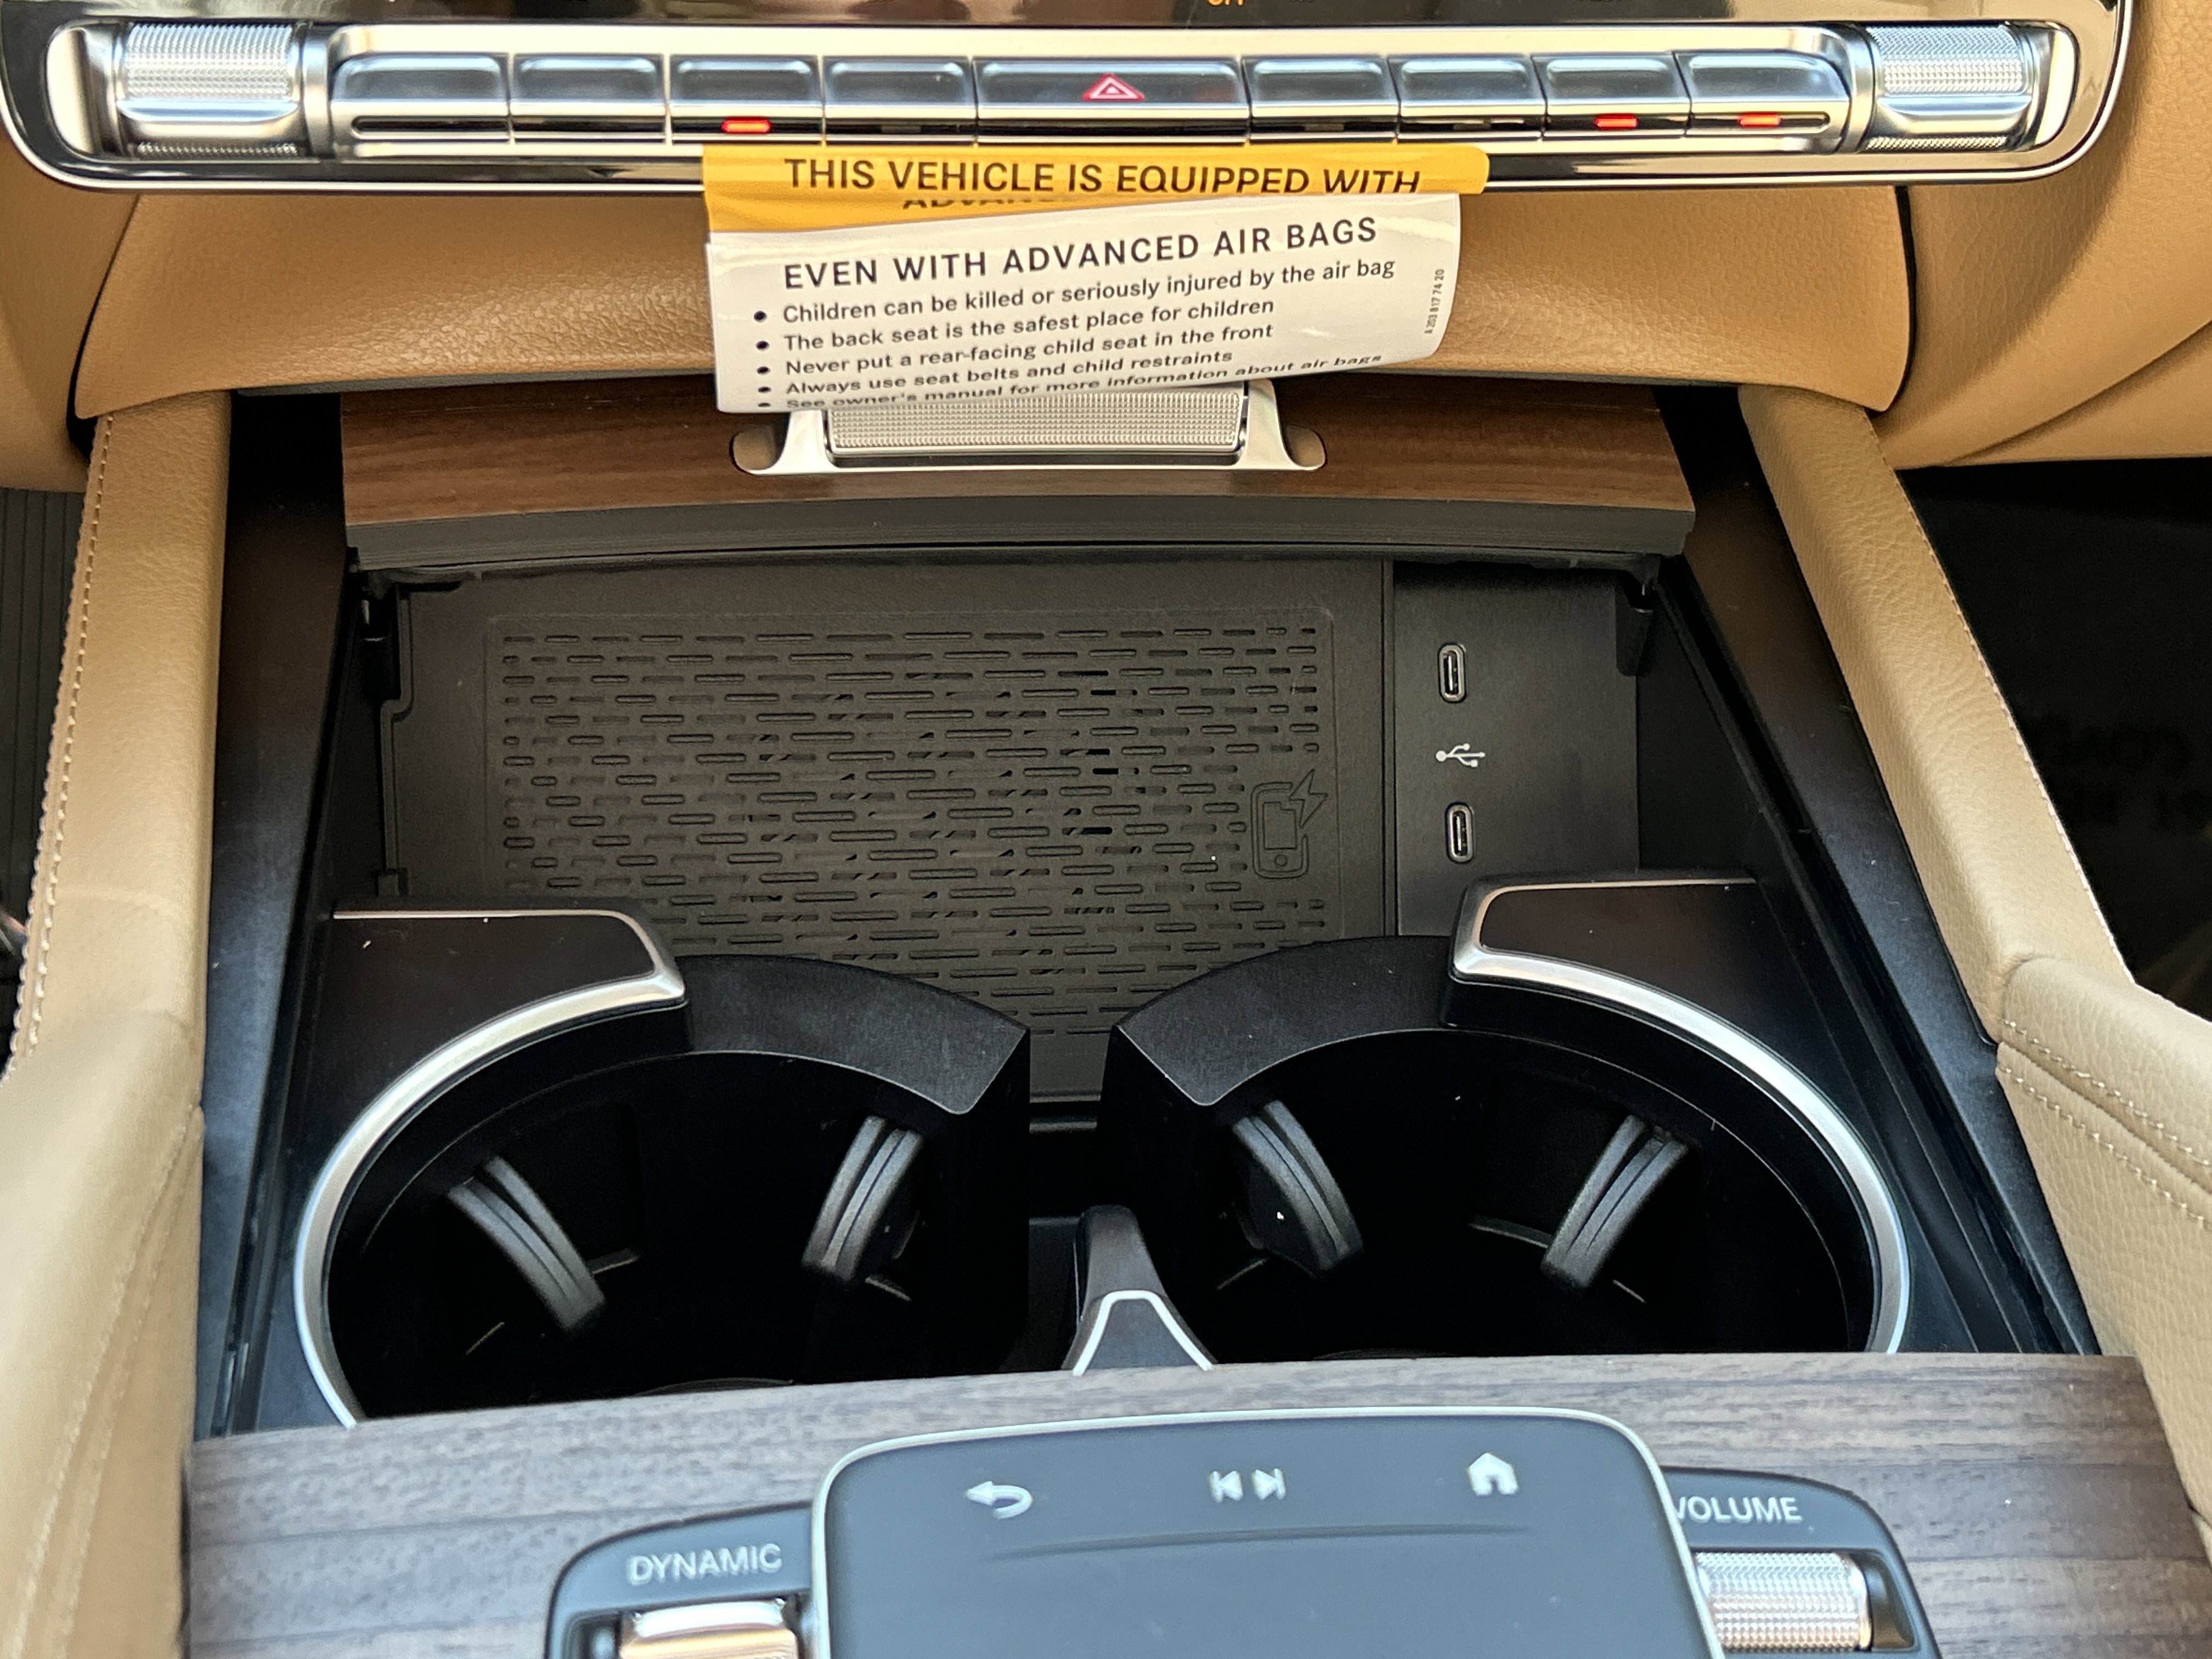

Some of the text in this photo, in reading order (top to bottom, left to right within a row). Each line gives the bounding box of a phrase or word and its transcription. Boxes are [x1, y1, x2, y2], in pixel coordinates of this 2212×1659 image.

[785, 158, 1420, 193] THIS VEHICLE IS EQUIPPED WITH
[785, 217, 1377, 289] EVEN WITH ADVANCED AIR BAGS
[1434, 268, 1444, 281] 20
[783, 259, 1395, 323] Children can be killed or seriously injured by the air bag
[785, 299, 1273, 351] The back seat is the safest place for children
[787, 324, 1273, 375] Never put a rear-facing child seat in the front
[786, 351, 1233, 394] Always use seat belts and child restraints
[787, 355, 1382, 408] See owner's manual for more information about air bags
[628, 1543, 782, 1585] DYNAMIC
